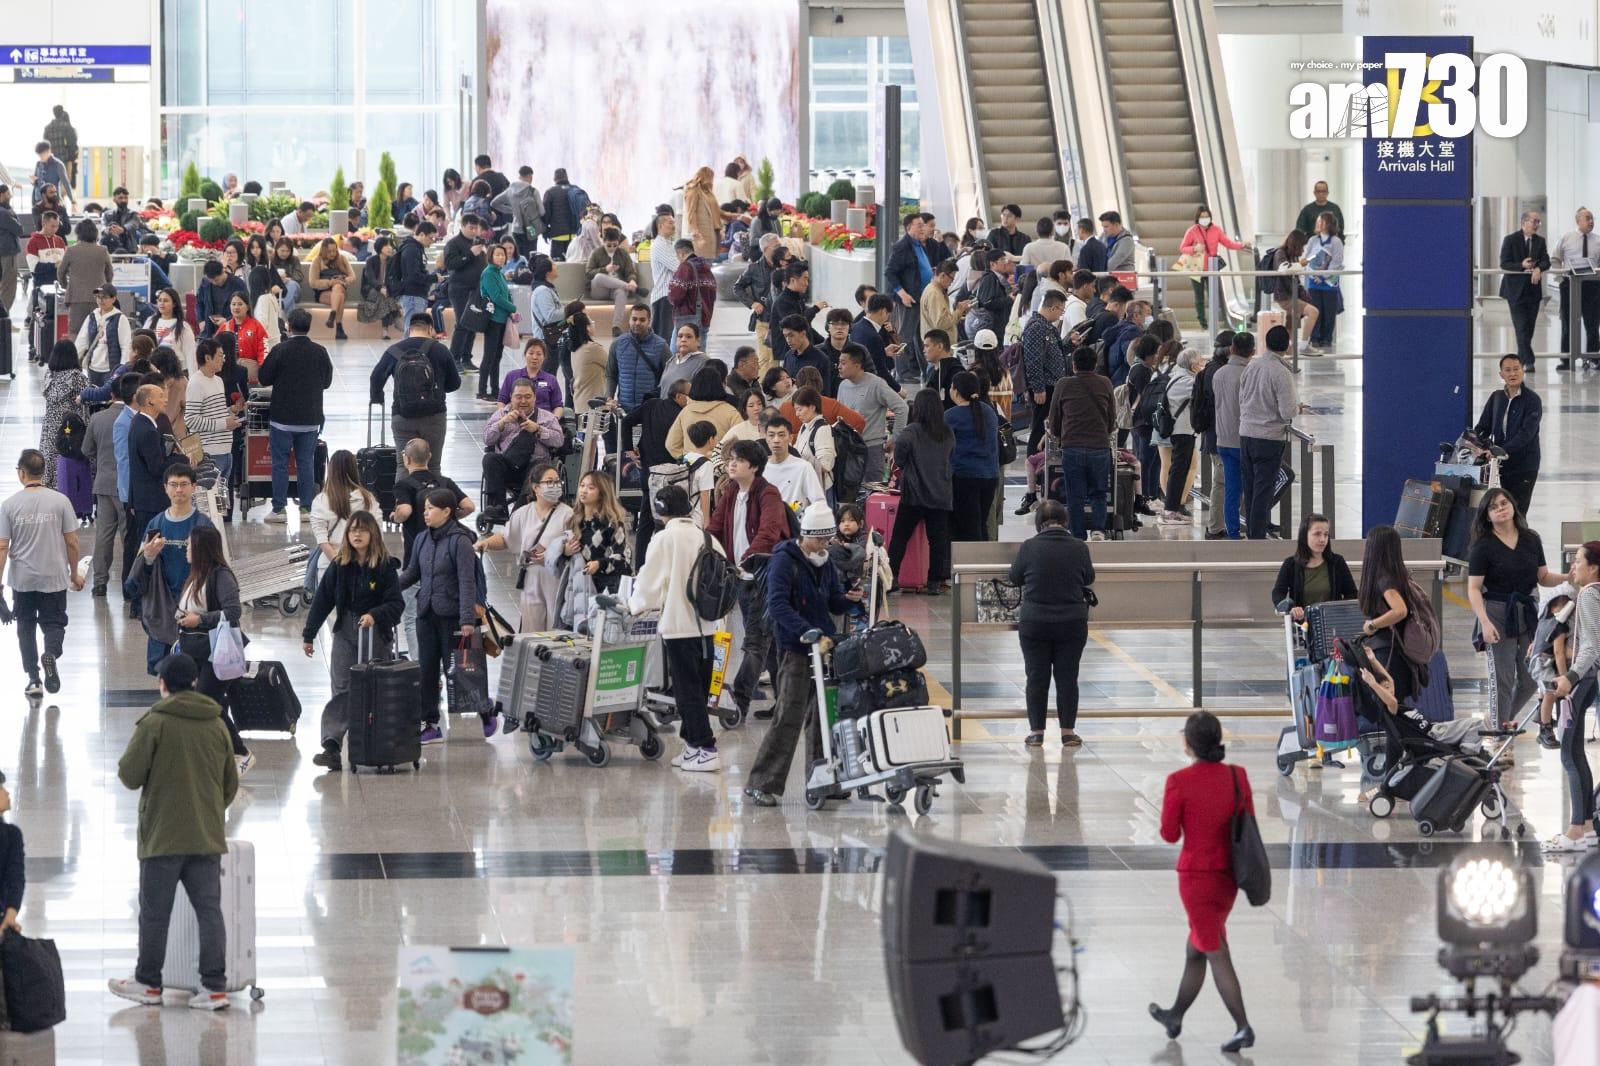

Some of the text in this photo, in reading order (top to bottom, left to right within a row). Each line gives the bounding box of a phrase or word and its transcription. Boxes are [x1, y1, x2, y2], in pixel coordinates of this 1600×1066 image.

[72, 56, 95, 64] Lounge
[1377, 141, 1455, 158] 接機大堂
[1378, 160, 1455, 172] Arrivals Hall
